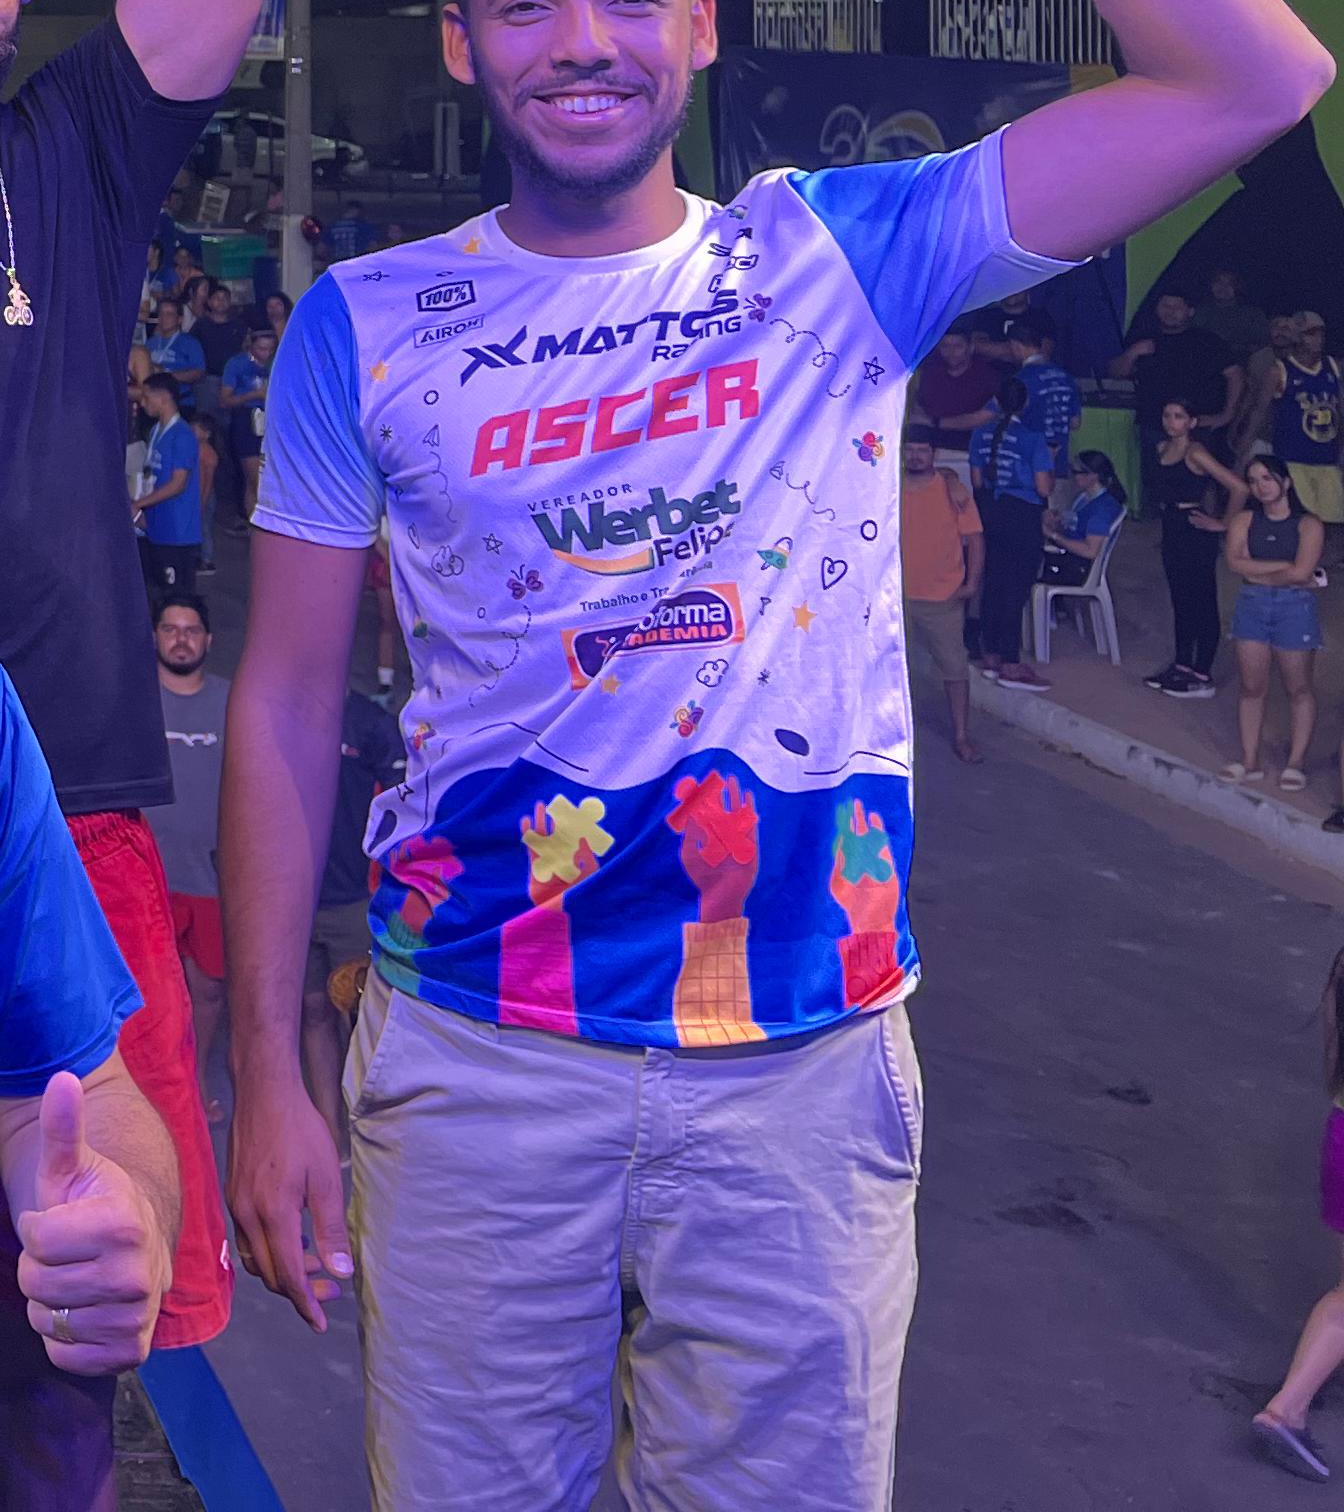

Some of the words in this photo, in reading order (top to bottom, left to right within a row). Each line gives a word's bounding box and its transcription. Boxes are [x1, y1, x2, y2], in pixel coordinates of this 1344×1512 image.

[426, 285, 466, 306] 100%
[470, 359, 760, 478] ASCER
[527, 483, 632, 512] VEREADOR
[530, 479, 741, 554] Werbet
[580, 593, 638, 612] Trabalho
